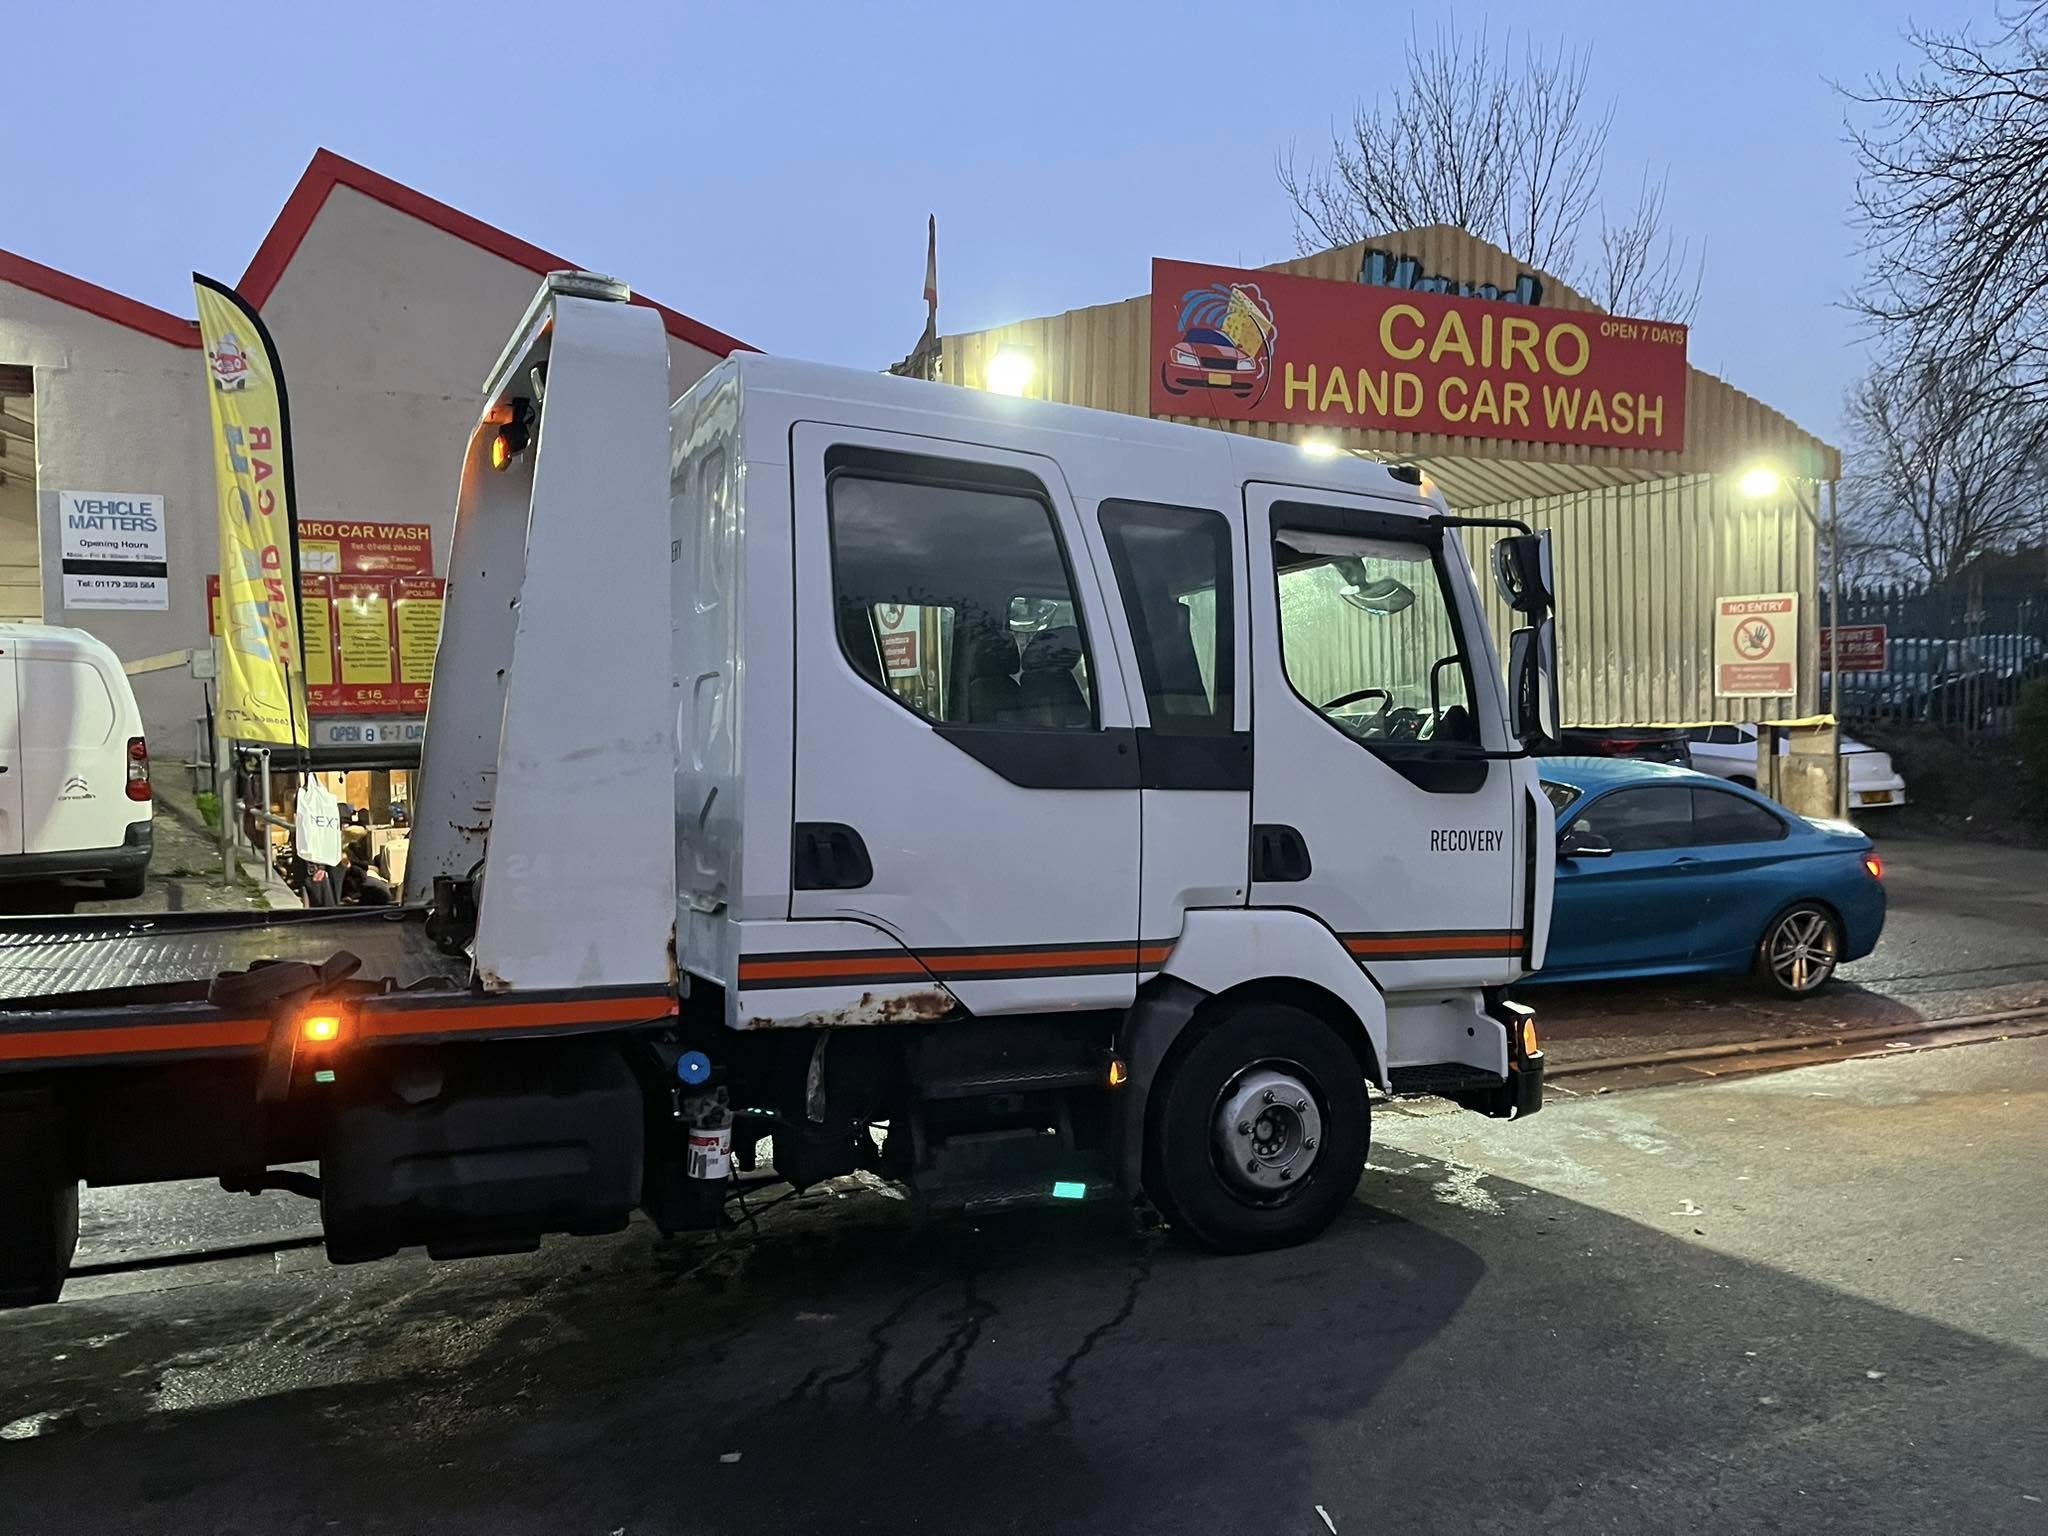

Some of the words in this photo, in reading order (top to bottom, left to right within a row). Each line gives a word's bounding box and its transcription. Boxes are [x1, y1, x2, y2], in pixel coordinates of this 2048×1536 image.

[1379, 303, 1590, 376] CAIRO
[1600, 320, 1637, 340] OPEN
[1641, 326, 1649, 340] 7
[1651, 327, 1685, 345] DAYS
[1284, 362, 1424, 418] HAND
[1438, 376, 1531, 427] CAR
[1542, 383, 1664, 437] WASH
[74, 499, 153, 517] VEHICLE
[68, 514, 158, 532] MATTERS
[298, 524, 334, 537] AIRO
[338, 525, 374, 538] CAR
[379, 526, 429, 540] WASH
[79, 539, 119, 548] Opening
[121, 540, 149, 548] Hours
[1729, 603, 1745, 613] NO
[1747, 601, 1785, 612] ENTRY
[308, 690, 323, 699] 15
[330, 726, 361, 741] OPEN
[1430, 830, 1504, 852] RECOVERY
